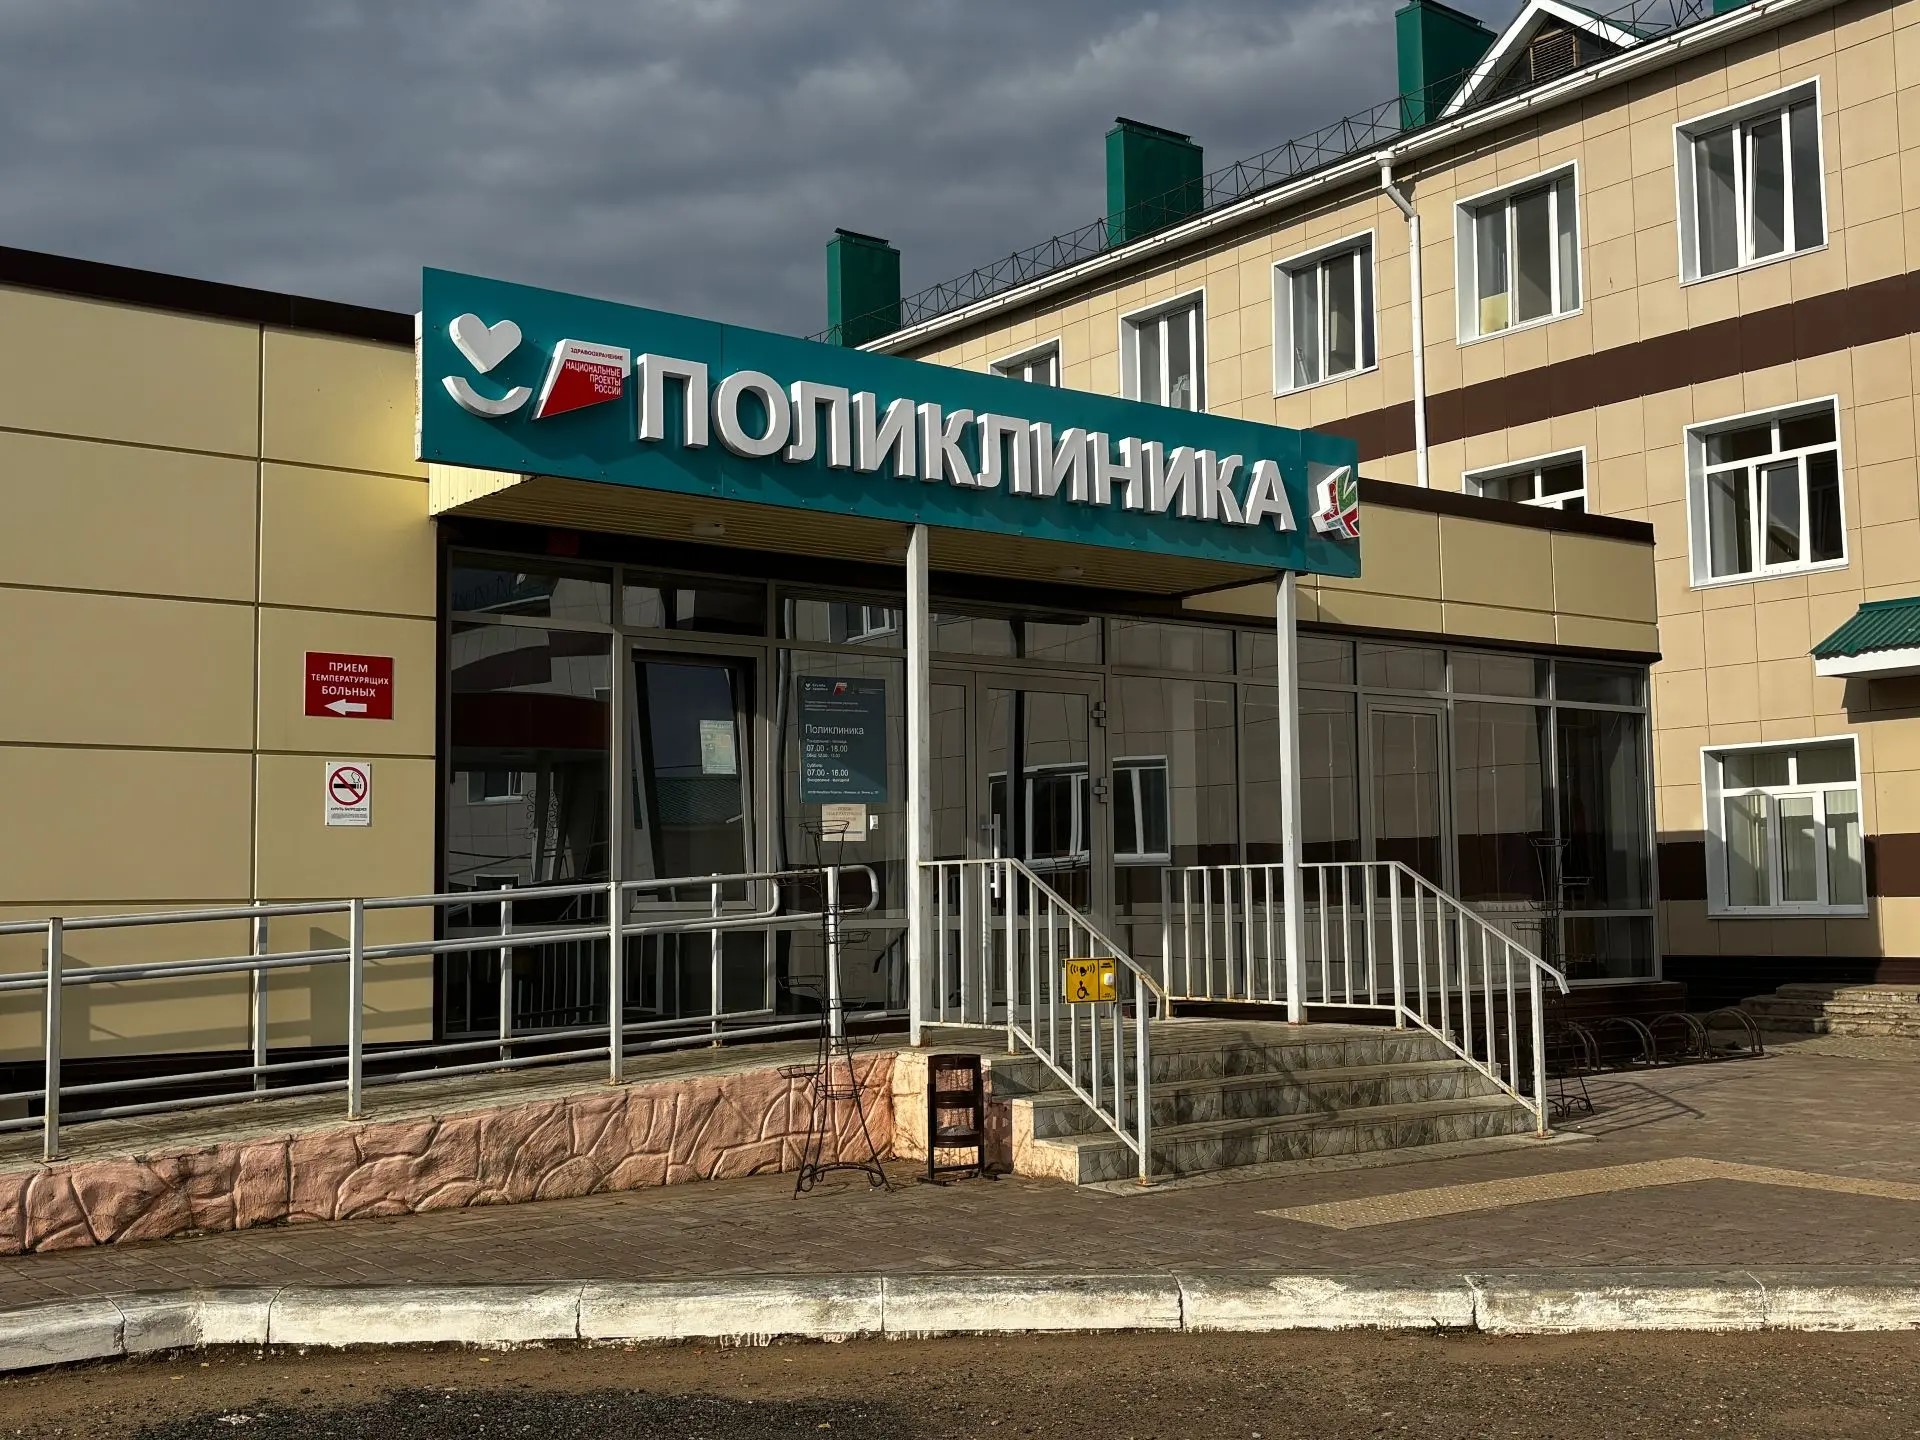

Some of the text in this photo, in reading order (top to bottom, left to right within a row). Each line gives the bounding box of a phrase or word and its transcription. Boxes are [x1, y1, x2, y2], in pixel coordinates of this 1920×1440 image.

[566, 361, 621, 376] НАЦИОНАЛЬНЫЕ
[590, 374, 621, 386] ПРОЕКТЫ
[595, 384, 621, 395] РОССИИ
[637, 353, 1297, 533] ПОЛИКЛИНИКА
[328, 662, 368, 673] ПРИЕМ
[311, 674, 388, 685] ТЕМПЕРАТУРЯЩИХ
[321, 685, 376, 697] БОЛЬНЫХ
[805, 723, 864, 735] Поликлиника
[806, 744, 825, 752] 07.00
[806, 769, 825, 777] 07.00
